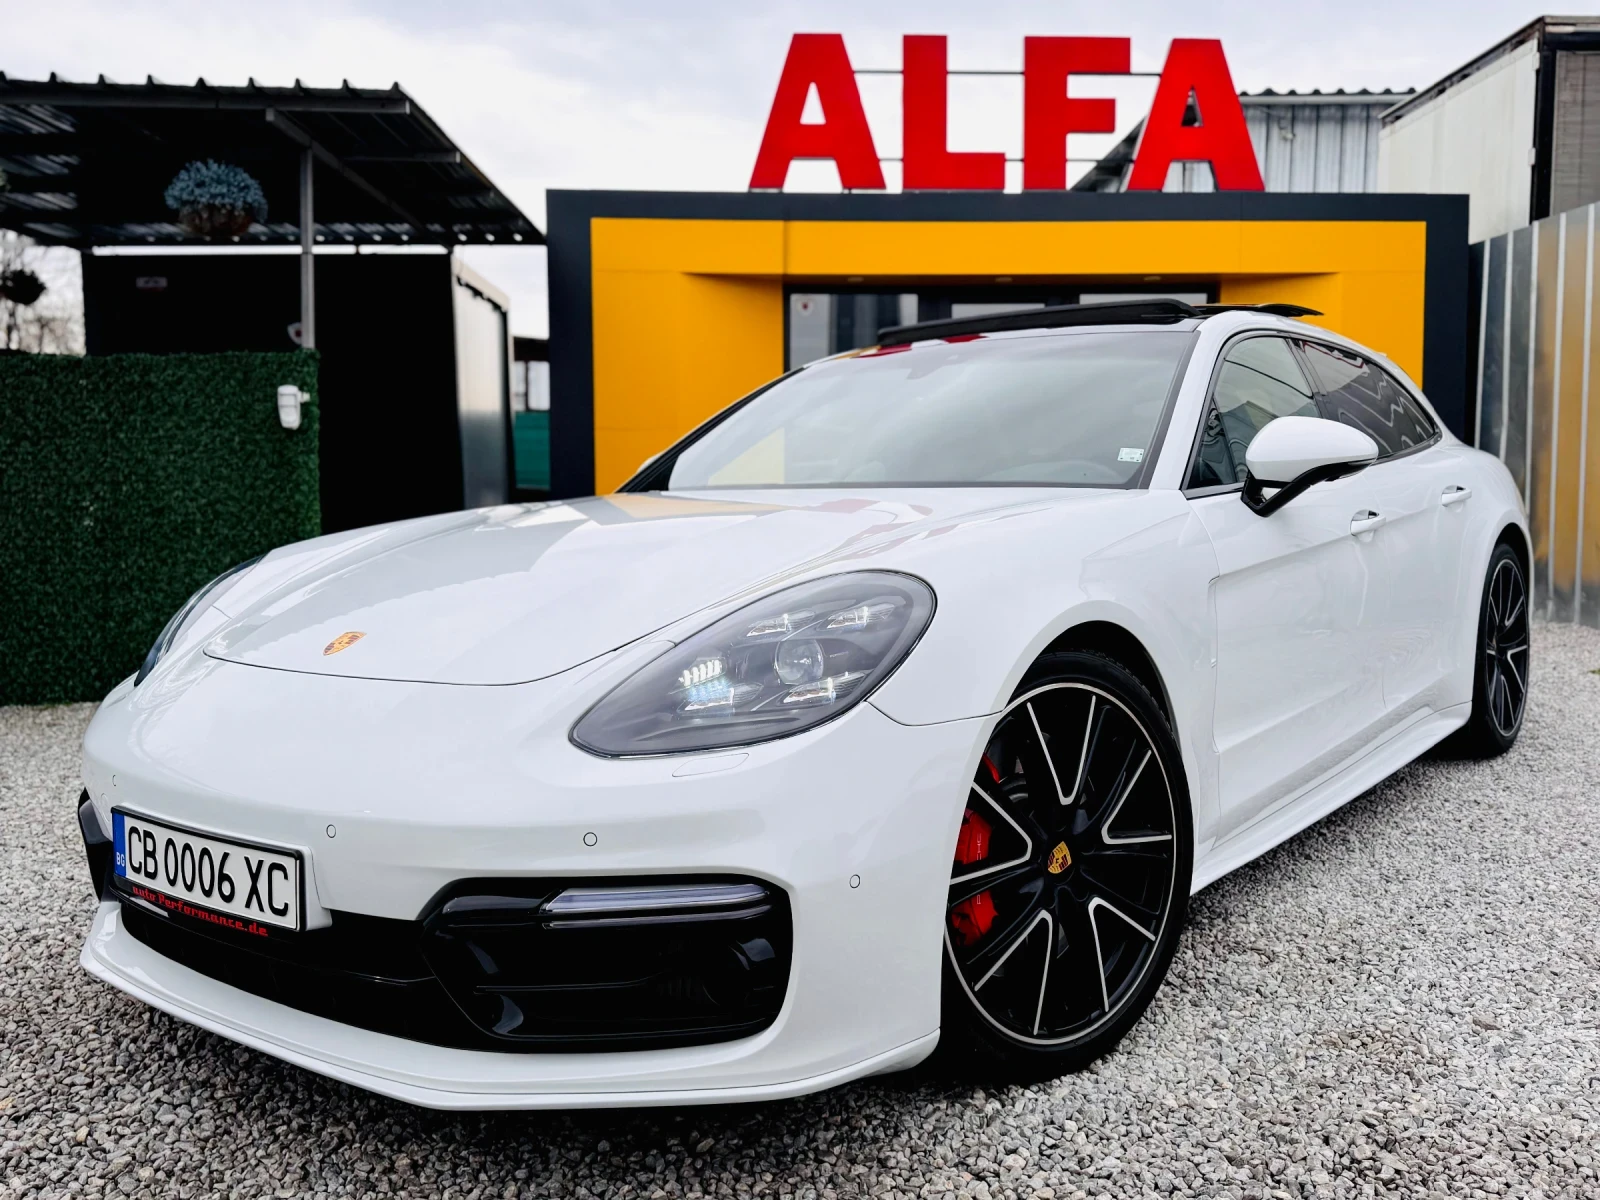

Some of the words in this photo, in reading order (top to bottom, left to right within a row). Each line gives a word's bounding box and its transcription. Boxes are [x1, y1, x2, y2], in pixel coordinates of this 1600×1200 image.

[750, 34, 1264, 191] ALFA
[116, 852, 125, 867] BG
[129, 826, 159, 880] CB
[164, 838, 236, 904] 0006
[244, 856, 289, 917] XC
